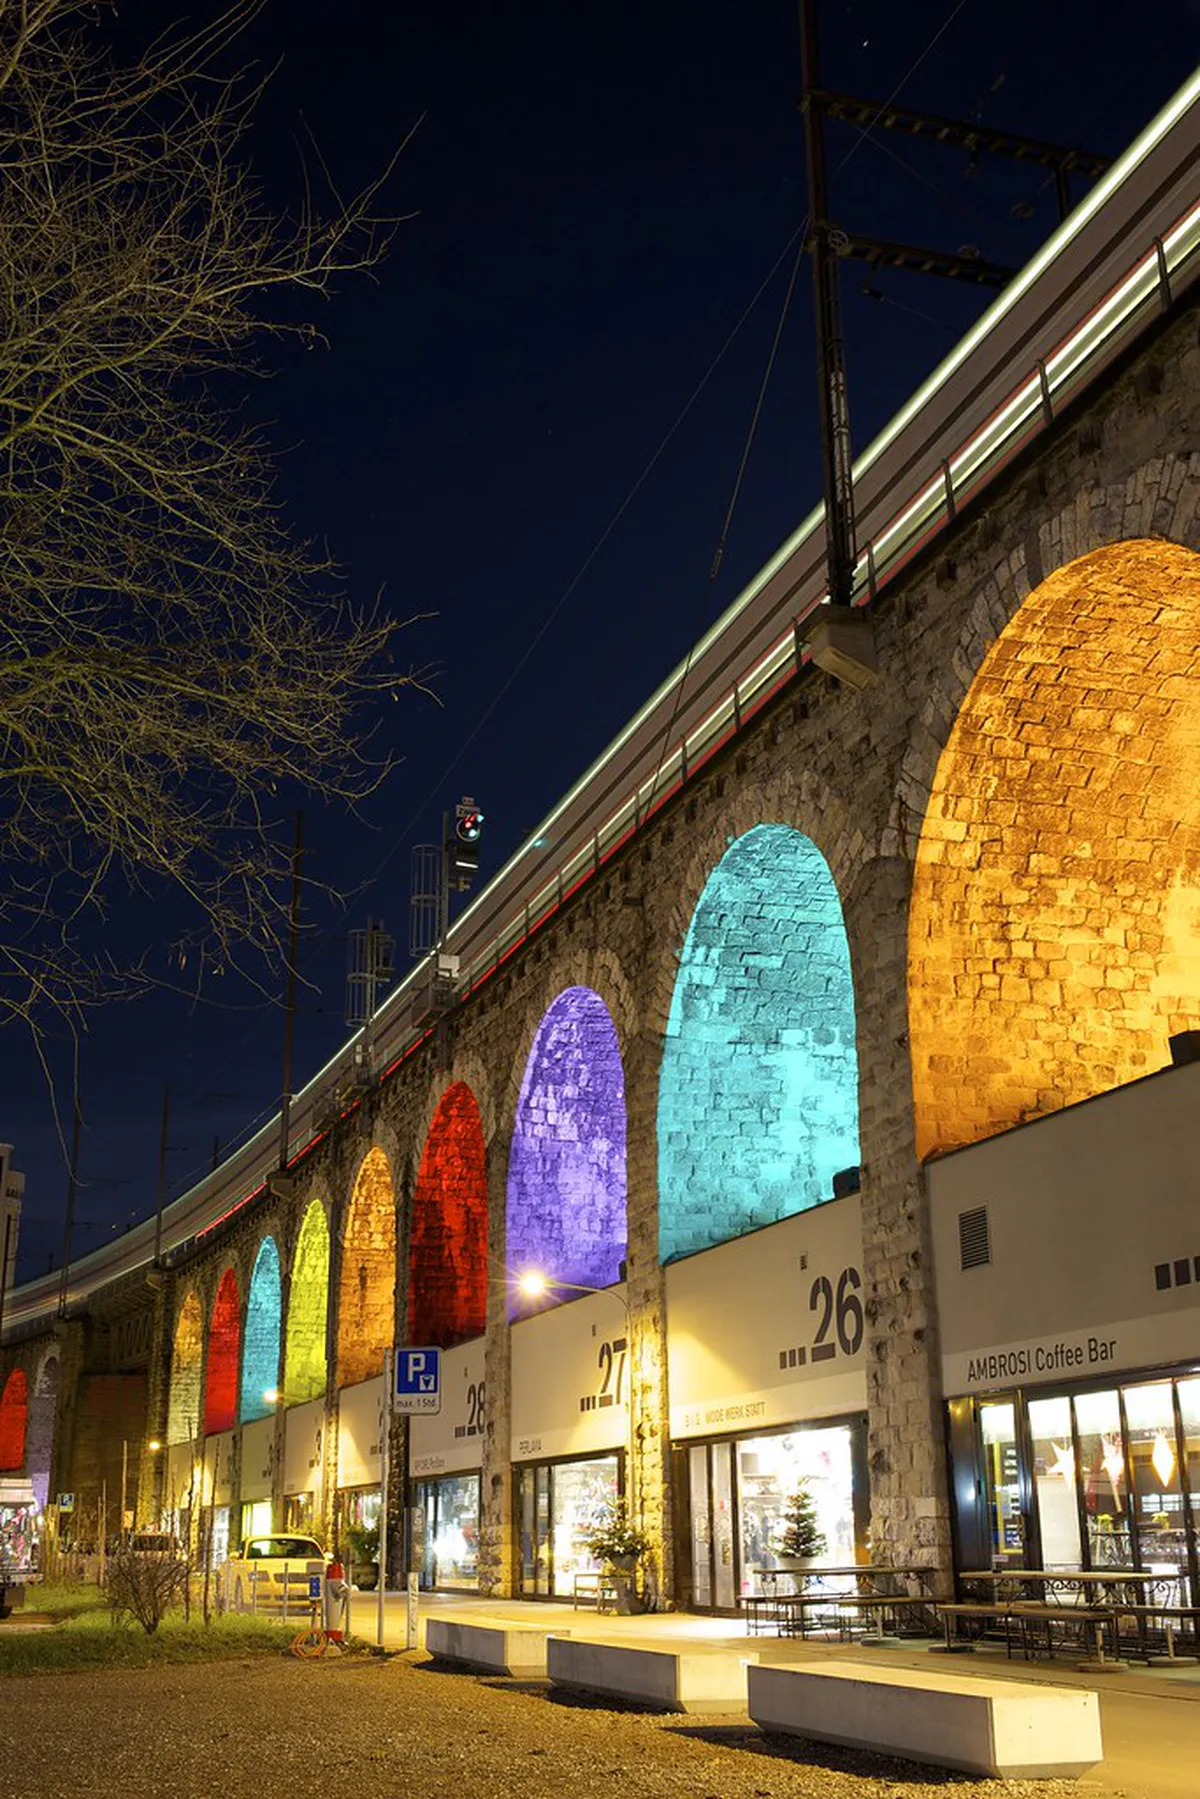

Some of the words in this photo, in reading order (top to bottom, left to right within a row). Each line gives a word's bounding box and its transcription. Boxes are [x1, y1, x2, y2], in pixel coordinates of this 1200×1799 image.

[809, 1267, 864, 1364] 26
[407, 1353, 426, 1382] P
[598, 1338, 627, 1408] 27
[967, 1349, 1032, 1383] AMBROSI
[1035, 1342, 1083, 1372] Coffee
[1088, 1337, 1117, 1363] Bar
[466, 1381, 486, 1436] 28
